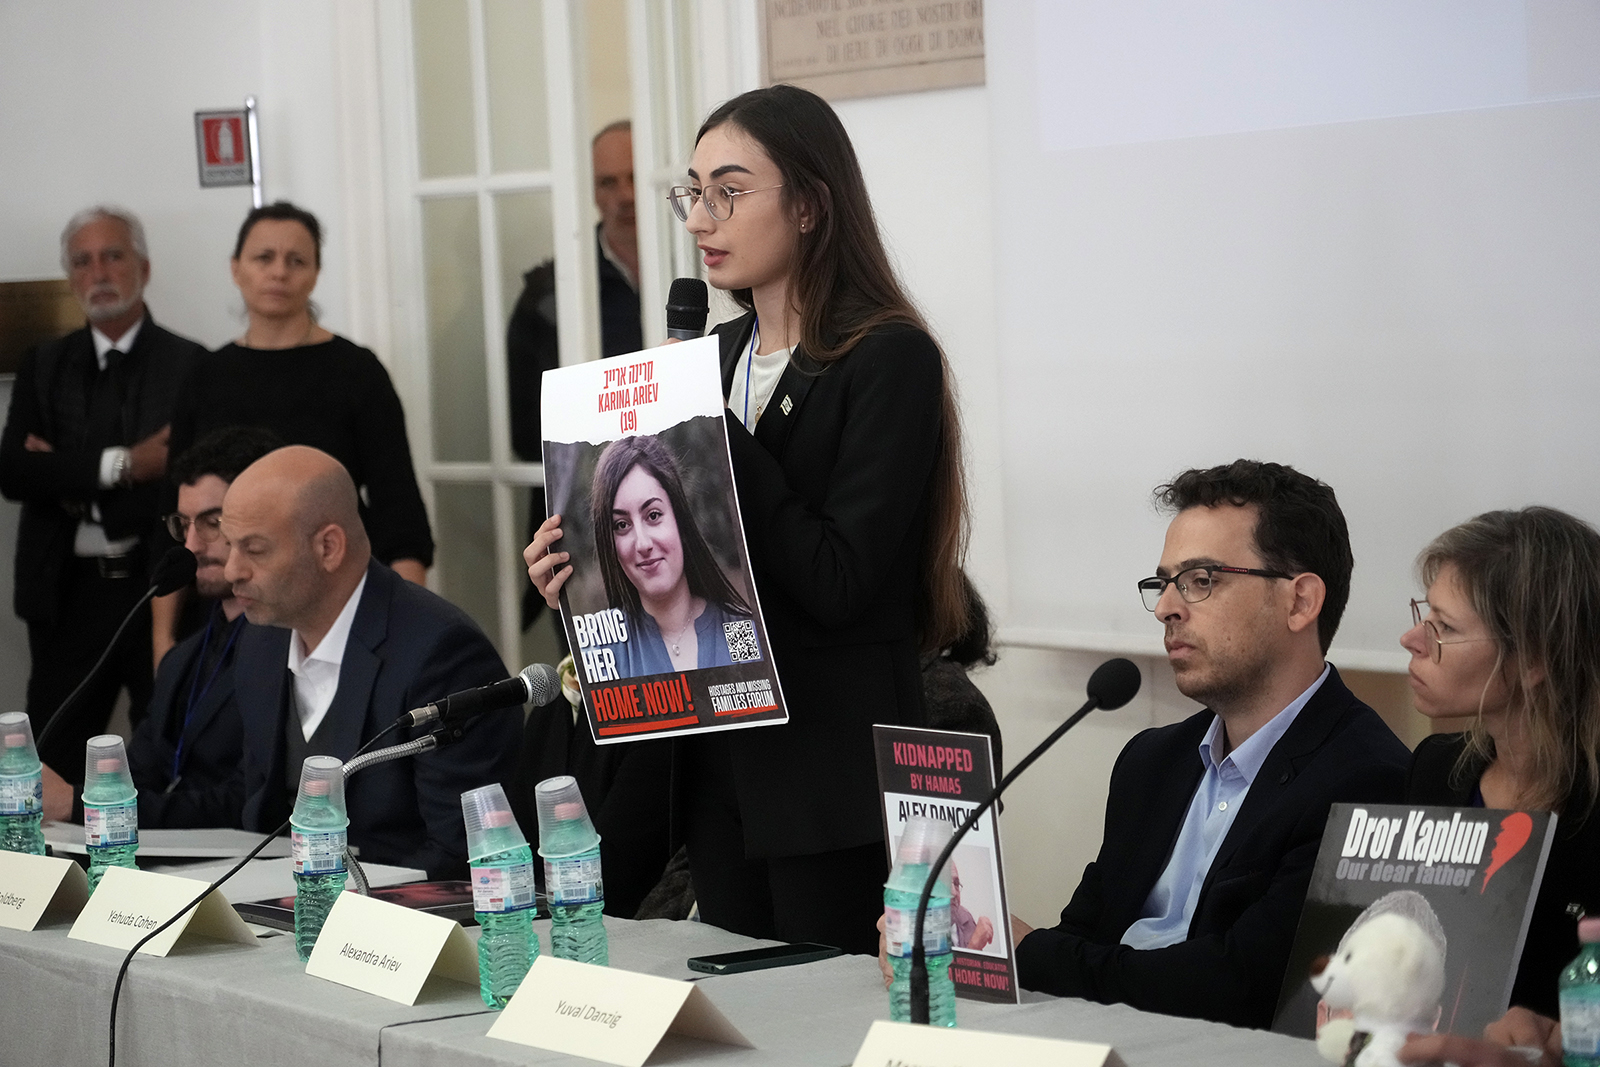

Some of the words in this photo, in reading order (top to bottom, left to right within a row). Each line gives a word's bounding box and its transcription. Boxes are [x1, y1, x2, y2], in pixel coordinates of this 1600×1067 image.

[603, 366, 627, 390] ארייב
[629, 360, 654, 384] קרינה
[598, 388, 631, 413] KARINA
[632, 382, 659, 406] ARIEV
[620, 408, 638, 434] (19)
[572, 608, 629, 648] BRING
[580, 648, 620, 684] HER
[590, 684, 644, 722] HOME
[641, 673, 695, 716] NOW!
[707, 682, 737, 697] HOSTAGES
[735, 681, 748, 694] AND
[746, 678, 772, 692] MISSING
[710, 693, 748, 713] FAMILIES
[746, 690, 776, 709] FORUM
[893, 741, 973, 773] KIDNAPPED
[910, 773, 923, 790] BY
[925, 775, 962, 795] HAMAS
[1341, 808, 1402, 860] Dror
[1397, 810, 1489, 867] Kaplun
[1336, 858, 1370, 881] Our
[1369, 860, 1416, 884] dear
[1415, 864, 1477, 888] father
[0, 891, 26, 910] oldberg
[107, 909, 135, 926] Yehuda
[133, 914, 158, 930] Cohen
[339, 942, 380, 966] Alexandra
[378, 954, 402, 972] Ariev
[954, 967, 982, 987] HOME
[983, 972, 1010, 992] NOW!
[554, 1000, 588, 1019] Yuval
[583, 1006, 622, 1029] Danzig
